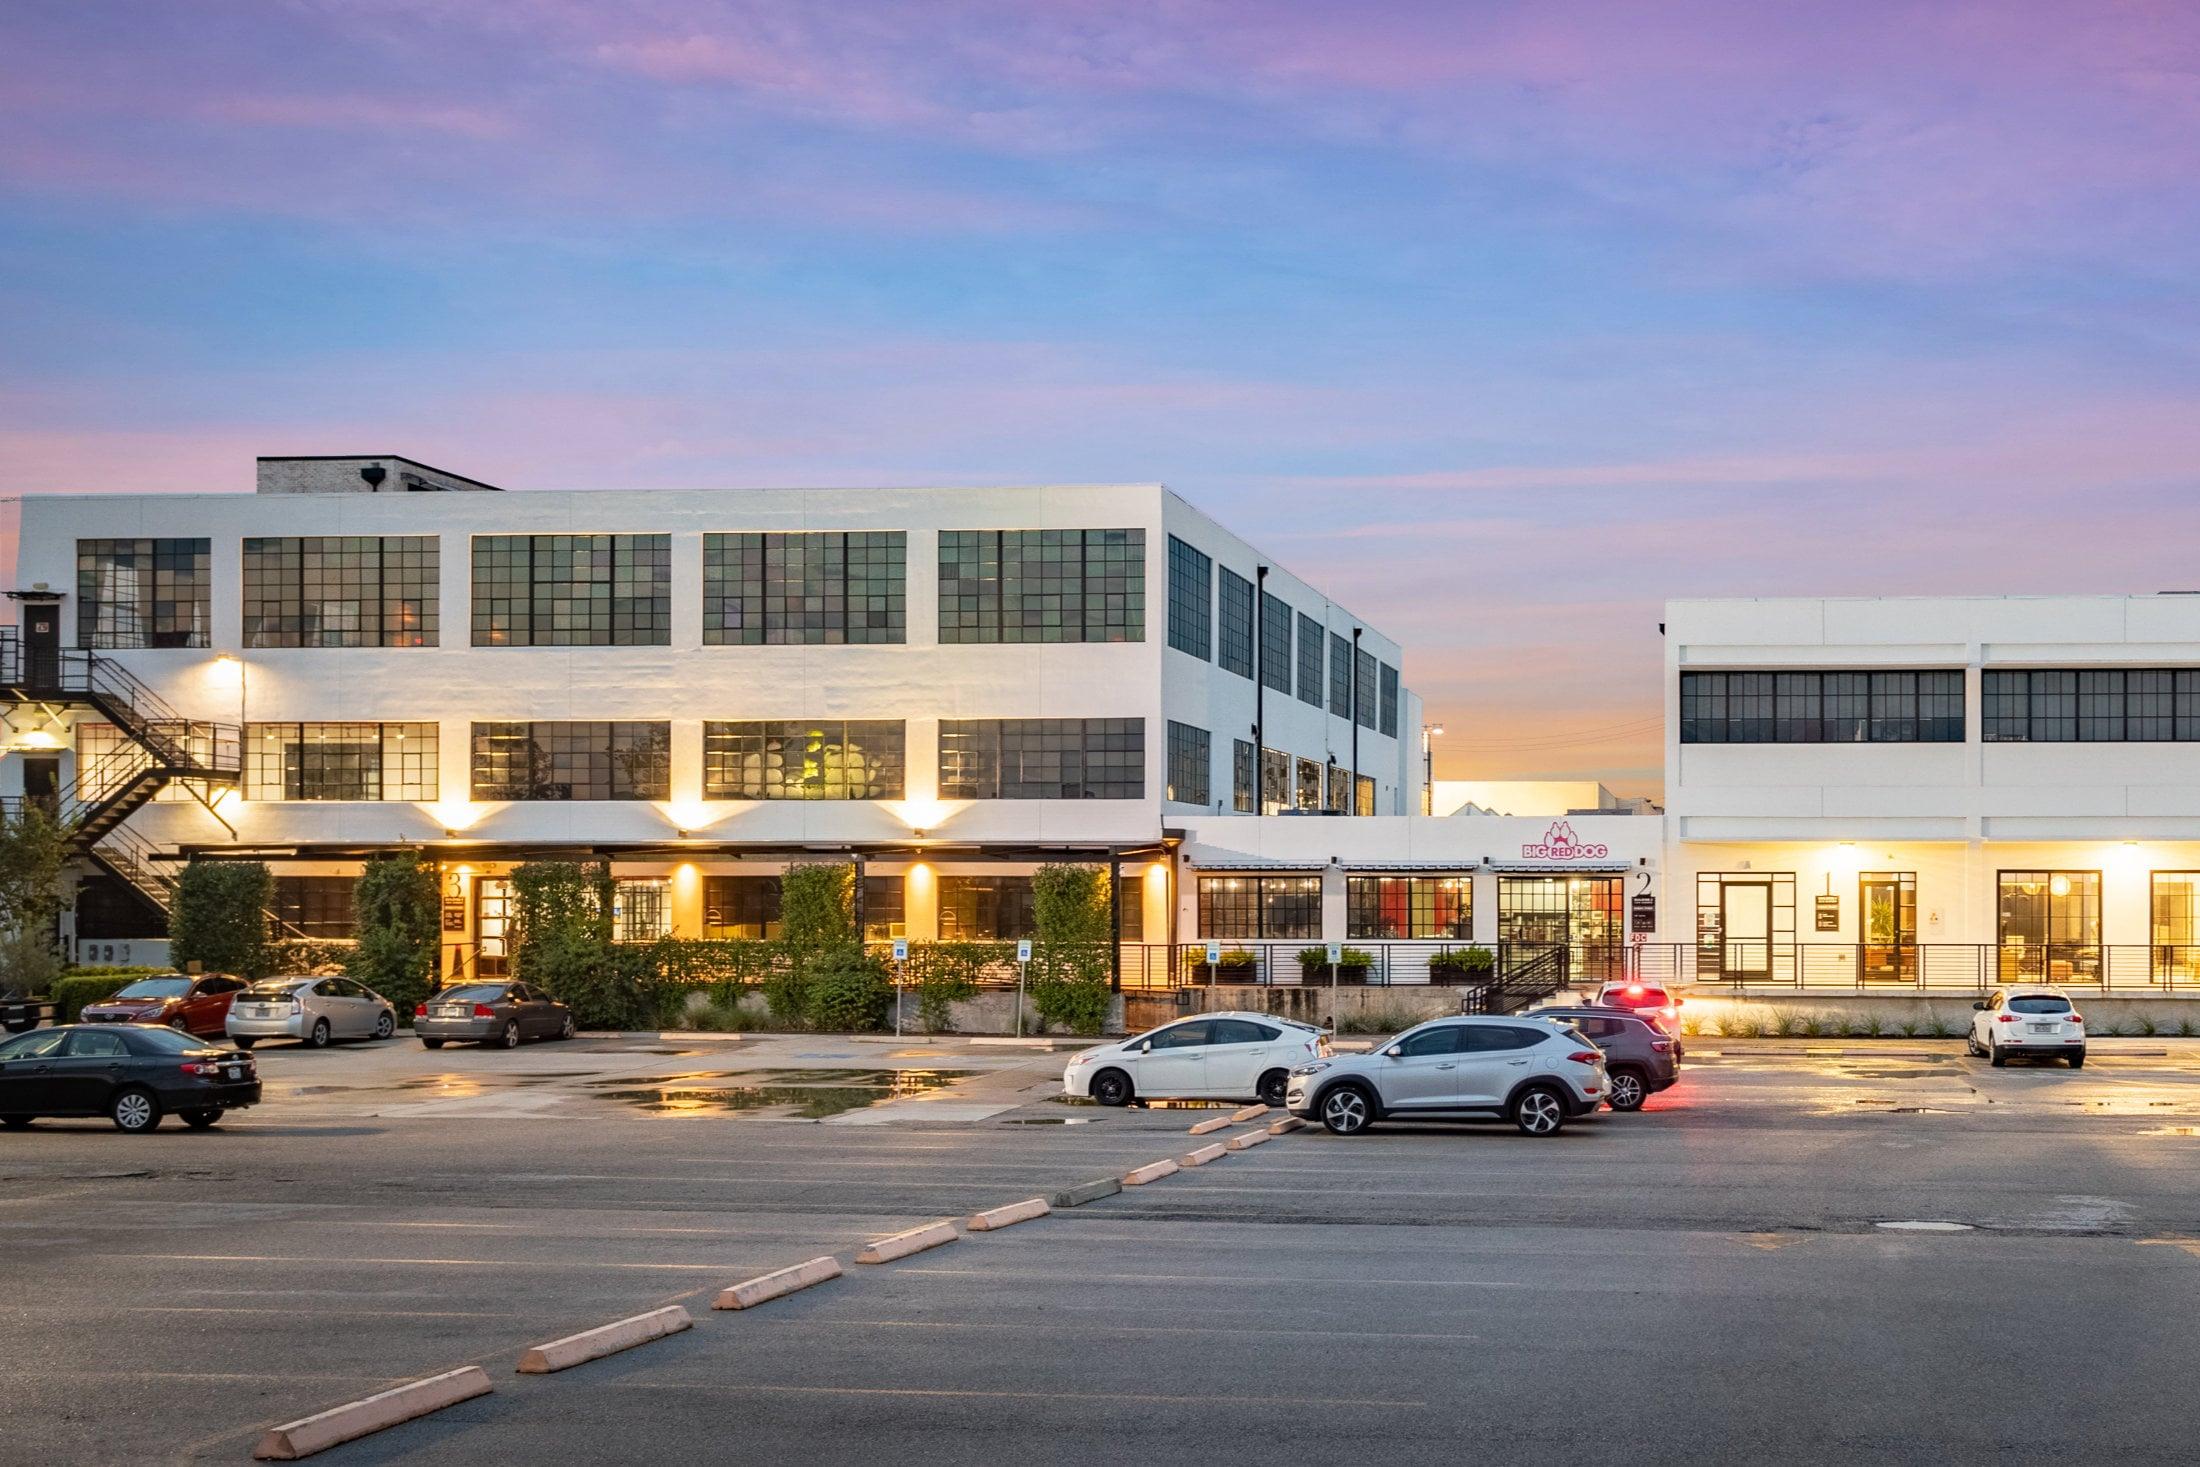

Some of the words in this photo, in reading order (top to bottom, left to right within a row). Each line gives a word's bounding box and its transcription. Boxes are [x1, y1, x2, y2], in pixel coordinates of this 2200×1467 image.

[1522, 844, 1548, 858] BIG
[1550, 846, 1573, 857] RED
[1574, 844, 1608, 858] DOG
[447, 873, 462, 898] 3
[1635, 872, 1652, 897] 2
[1630, 934, 1646, 942] FDC
